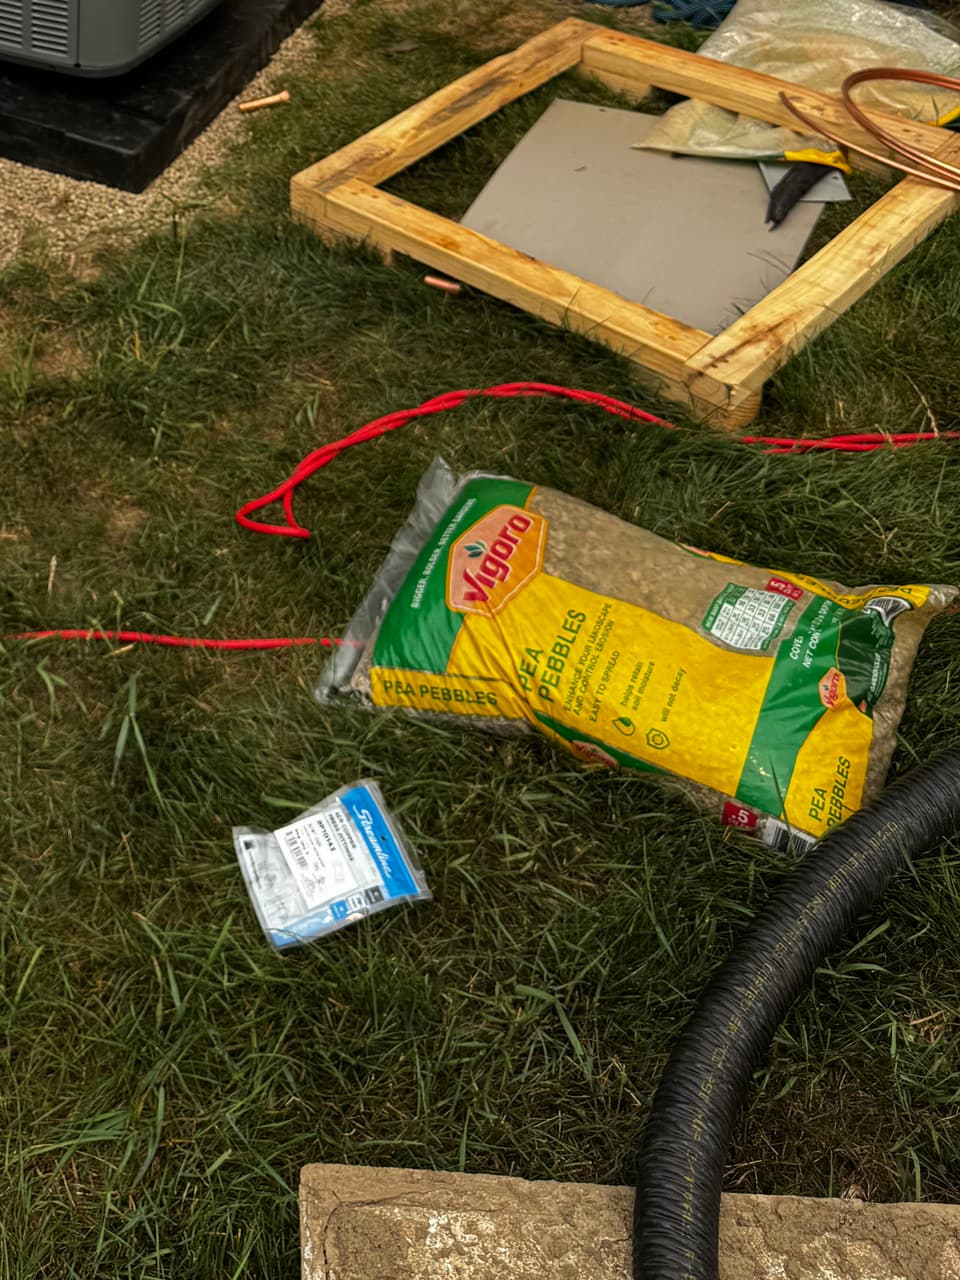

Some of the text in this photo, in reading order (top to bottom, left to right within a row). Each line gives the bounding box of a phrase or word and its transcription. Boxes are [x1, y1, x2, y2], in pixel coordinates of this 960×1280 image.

[463, 513, 534, 603] Vigoro
[519, 646, 545, 693] PEA
[537, 609, 587, 703] PEBBLES
[562, 602, 613, 712] ENHANCE YOUR LANDSCAPE
[573, 619, 616, 716] AND CONTROL EROSION
[589, 650, 620, 722] EASY TO SPREAD
[667, 692, 677, 708] not
[672, 667, 688, 693] decay
[802, 648, 814, 669] NET
[825, 672, 841, 706] Vigoro
[383, 680, 498, 706] PEA PEBBLES
[808, 787, 828, 822] PEA
[825, 756, 851, 827] PEBBLES
[352, 805, 392, 879] Streamline
